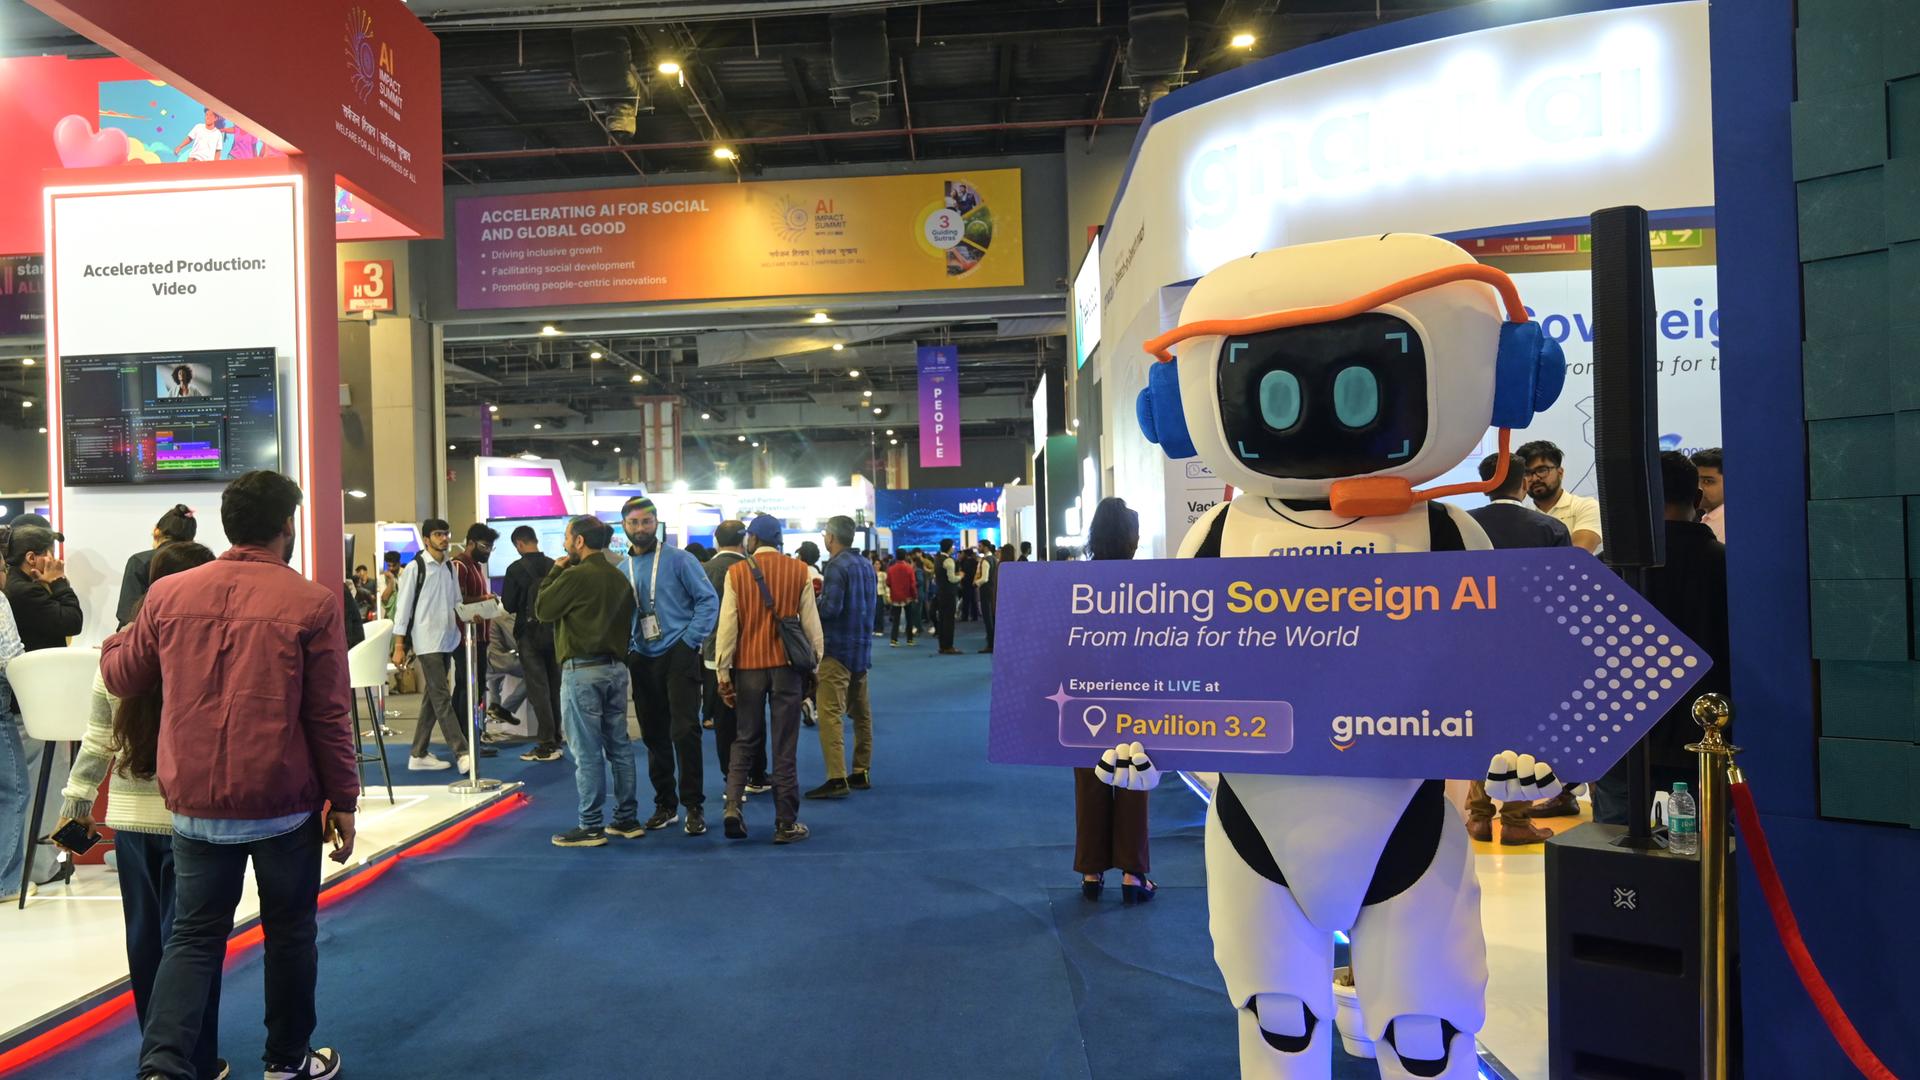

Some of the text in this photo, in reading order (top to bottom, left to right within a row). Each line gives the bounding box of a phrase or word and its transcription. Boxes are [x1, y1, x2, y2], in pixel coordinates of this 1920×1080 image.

[380, 42, 394, 76] AI
[379, 67, 401, 95] IMPACT
[379, 82, 403, 110] SUMMIT
[481, 199, 710, 224] ACCELERATING AI FOR SOCIAL
[815, 199, 834, 214] AI
[815, 214, 845, 222] IMPACT
[815, 221, 848, 230] SUMMIT
[939, 215, 950, 228] 3
[481, 221, 626, 242] AND GLOBAL GOOD
[492, 246, 602, 260] Driving inclusive growth
[84, 257, 266, 278] Accelerated Production:
[492, 260, 635, 276] Facilitating social development
[152, 282, 197, 296] Video
[492, 276, 668, 294] Promoting people-centric innovations
[1671, 356, 1702, 376] for
[934, 388, 944, 458] PEOPLE
[1072, 575, 1497, 622] Building Sovereign AI
[1068, 626, 1360, 647] From India for the World
[1070, 678, 1220, 693] Experience it LIVE at
[1116, 714, 1267, 738] Pavilion 3.2
[1332, 709, 1473, 742] gnani.ai
